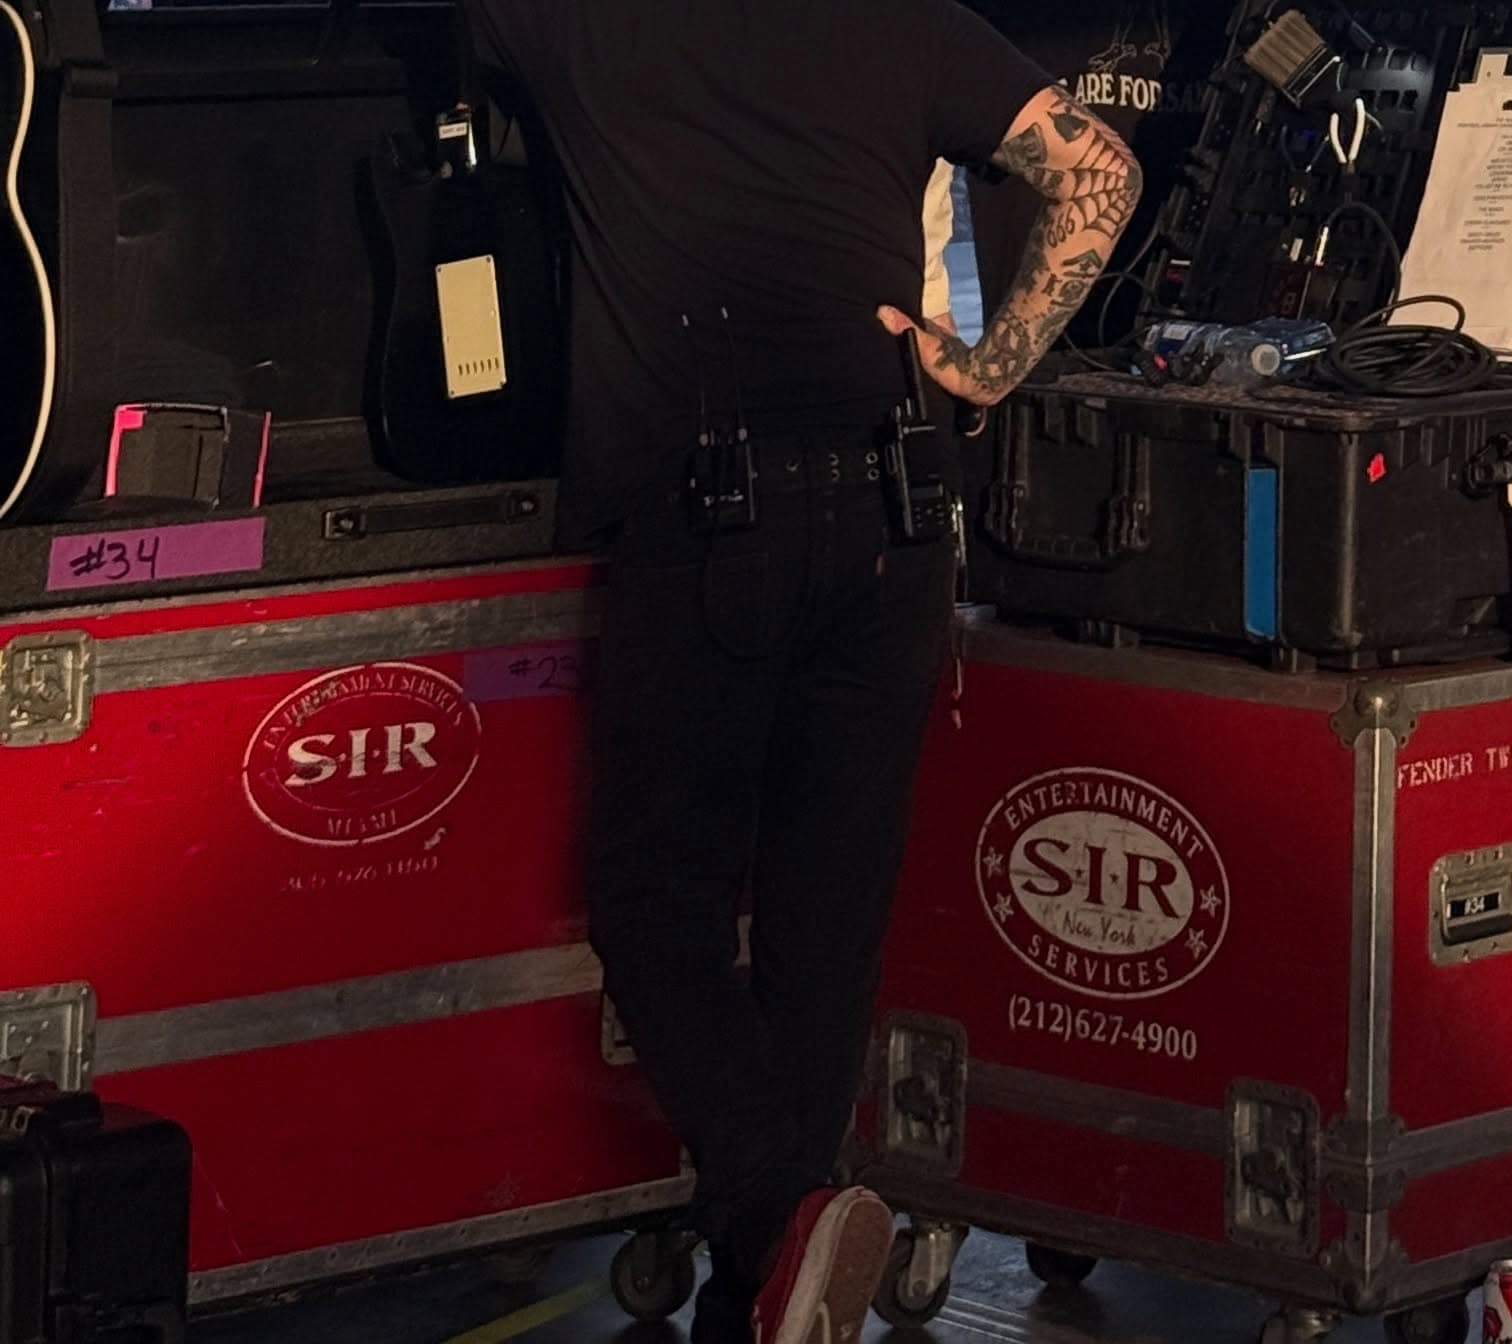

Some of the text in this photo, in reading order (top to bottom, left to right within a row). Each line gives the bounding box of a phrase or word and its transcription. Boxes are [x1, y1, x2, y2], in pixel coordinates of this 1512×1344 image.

[1075, 73, 1116, 106] ARE
[69, 536, 160, 581] #34
[1397, 752, 1474, 789] FENDER
[1004, 781, 1205, 860] ENTERTAINMENT
[1027, 933, 1169, 988] SERVICES
[1008, 993, 1198, 1062] (212)627-4900
